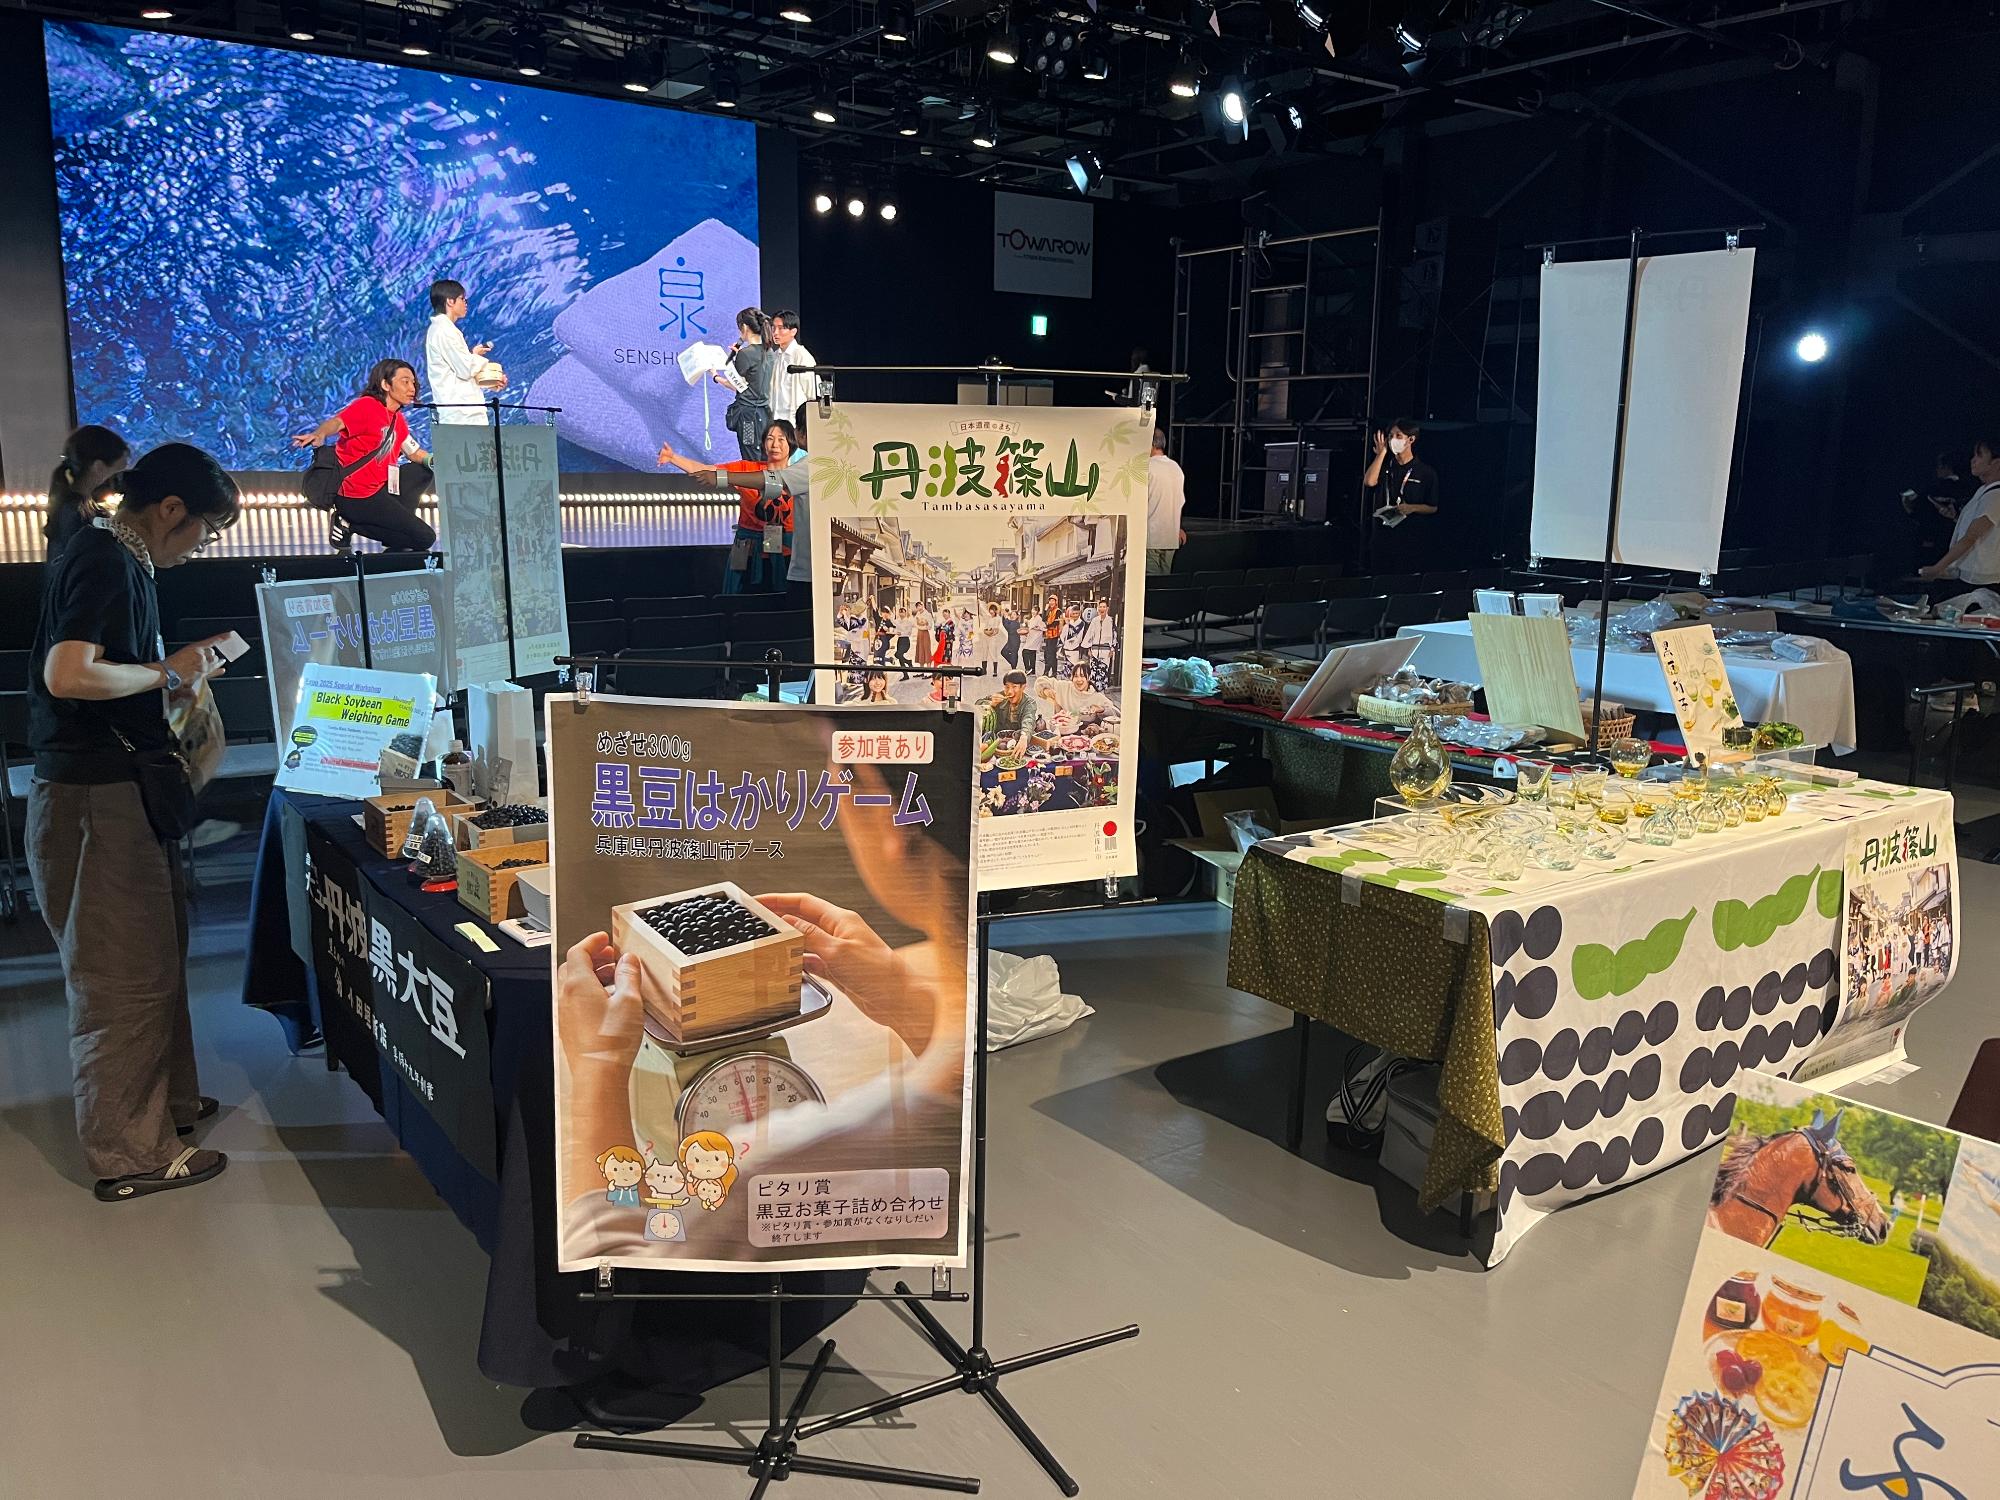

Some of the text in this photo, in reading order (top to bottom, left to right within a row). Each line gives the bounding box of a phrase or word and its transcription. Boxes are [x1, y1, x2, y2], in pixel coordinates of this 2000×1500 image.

[996, 228, 1090, 256] TOWAROW
[658, 257, 708, 339] 泉
[960, 421, 1011, 432] 日本遺産のまち
[859, 435, 1100, 503] 丹波篠山
[921, 501, 1046, 513] Tambasasayama
[316, 692, 341, 705] Black
[344, 695, 382, 710] Soybean
[341, 709, 383, 726] Weighing
[386, 713, 409, 727] Game
[596, 731, 692, 762] めざせ300g
[837, 734, 927, 760] 参加賞あり
[591, 762, 934, 831] 黒豆はかりゲーム
[594, 834, 784, 861] 兵庫県丹波篠山市ブース
[1859, 821, 1938, 875] 丹波篠山
[758, 1178, 831, 1198] ピタリ賞
[756, 1195, 945, 1220] 黒豆お菓子詰め合わせ
[771, 1231, 823, 1243] 終了します
